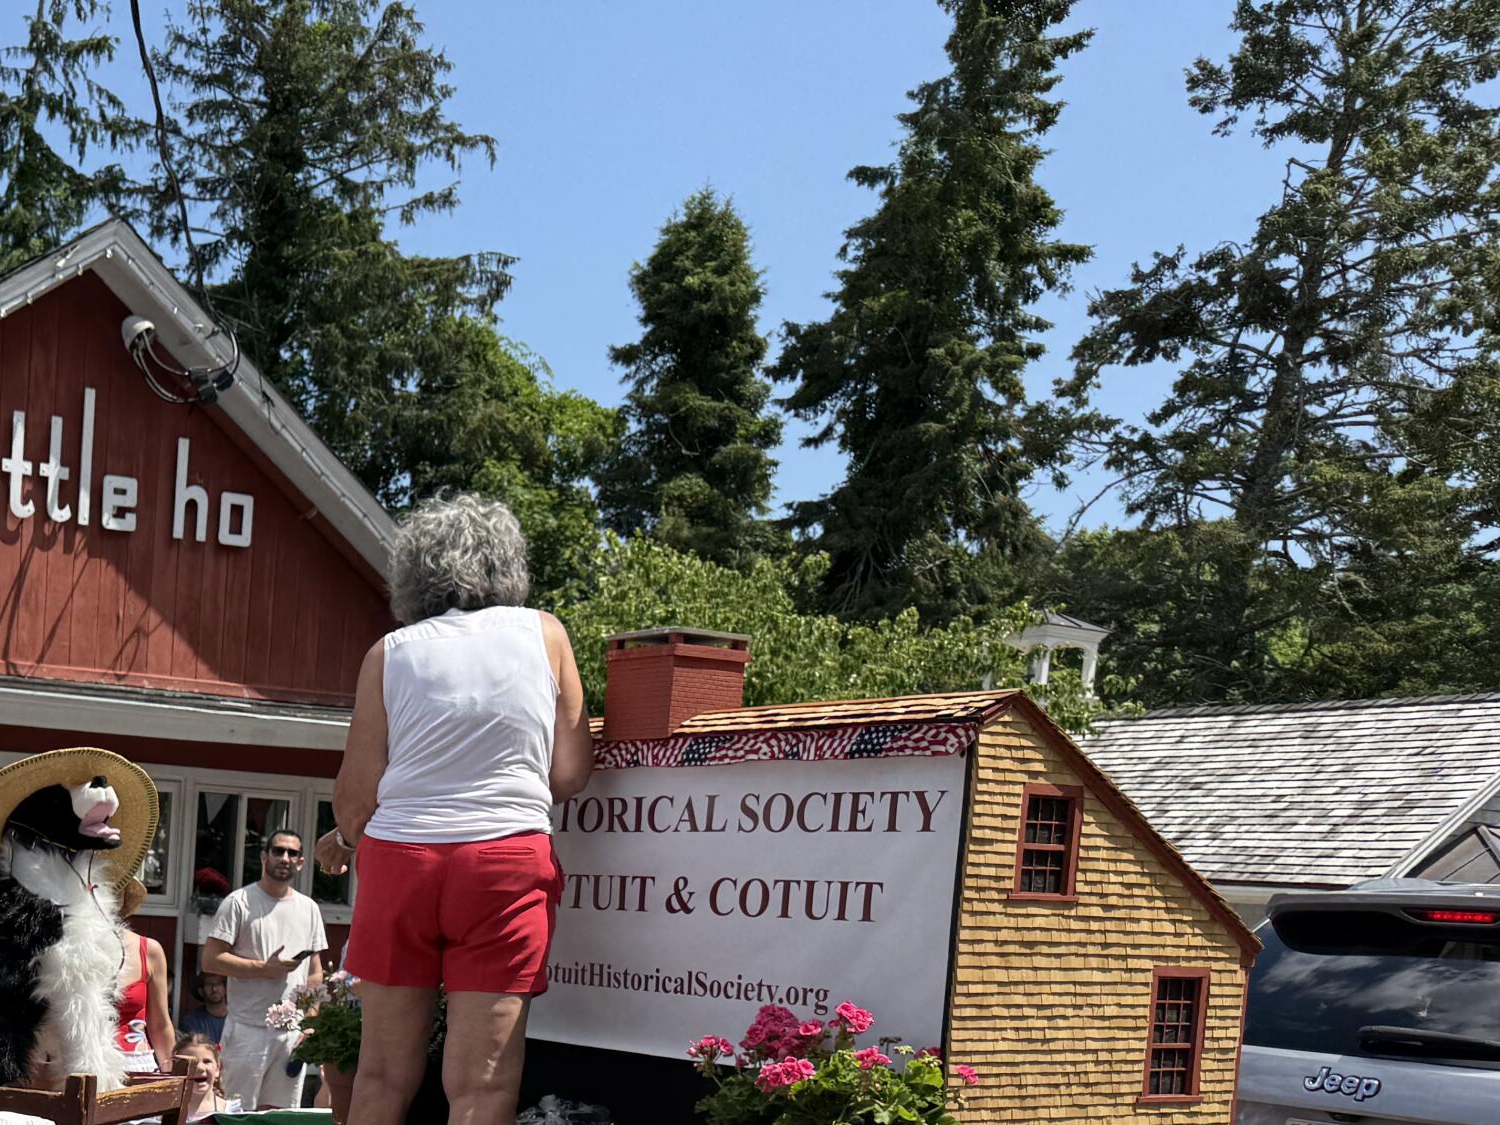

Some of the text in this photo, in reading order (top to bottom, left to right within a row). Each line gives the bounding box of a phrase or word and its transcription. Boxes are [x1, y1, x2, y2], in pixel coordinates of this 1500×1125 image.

[173, 437, 254, 548] ho
[556, 790, 948, 833] TORICAL SOCIETY
[564, 874, 884, 923] TUIT & COTUIT
[544, 962, 830, 1016] otuitHistoricalSociety.org
[1304, 1067, 1381, 1101] Jeep
